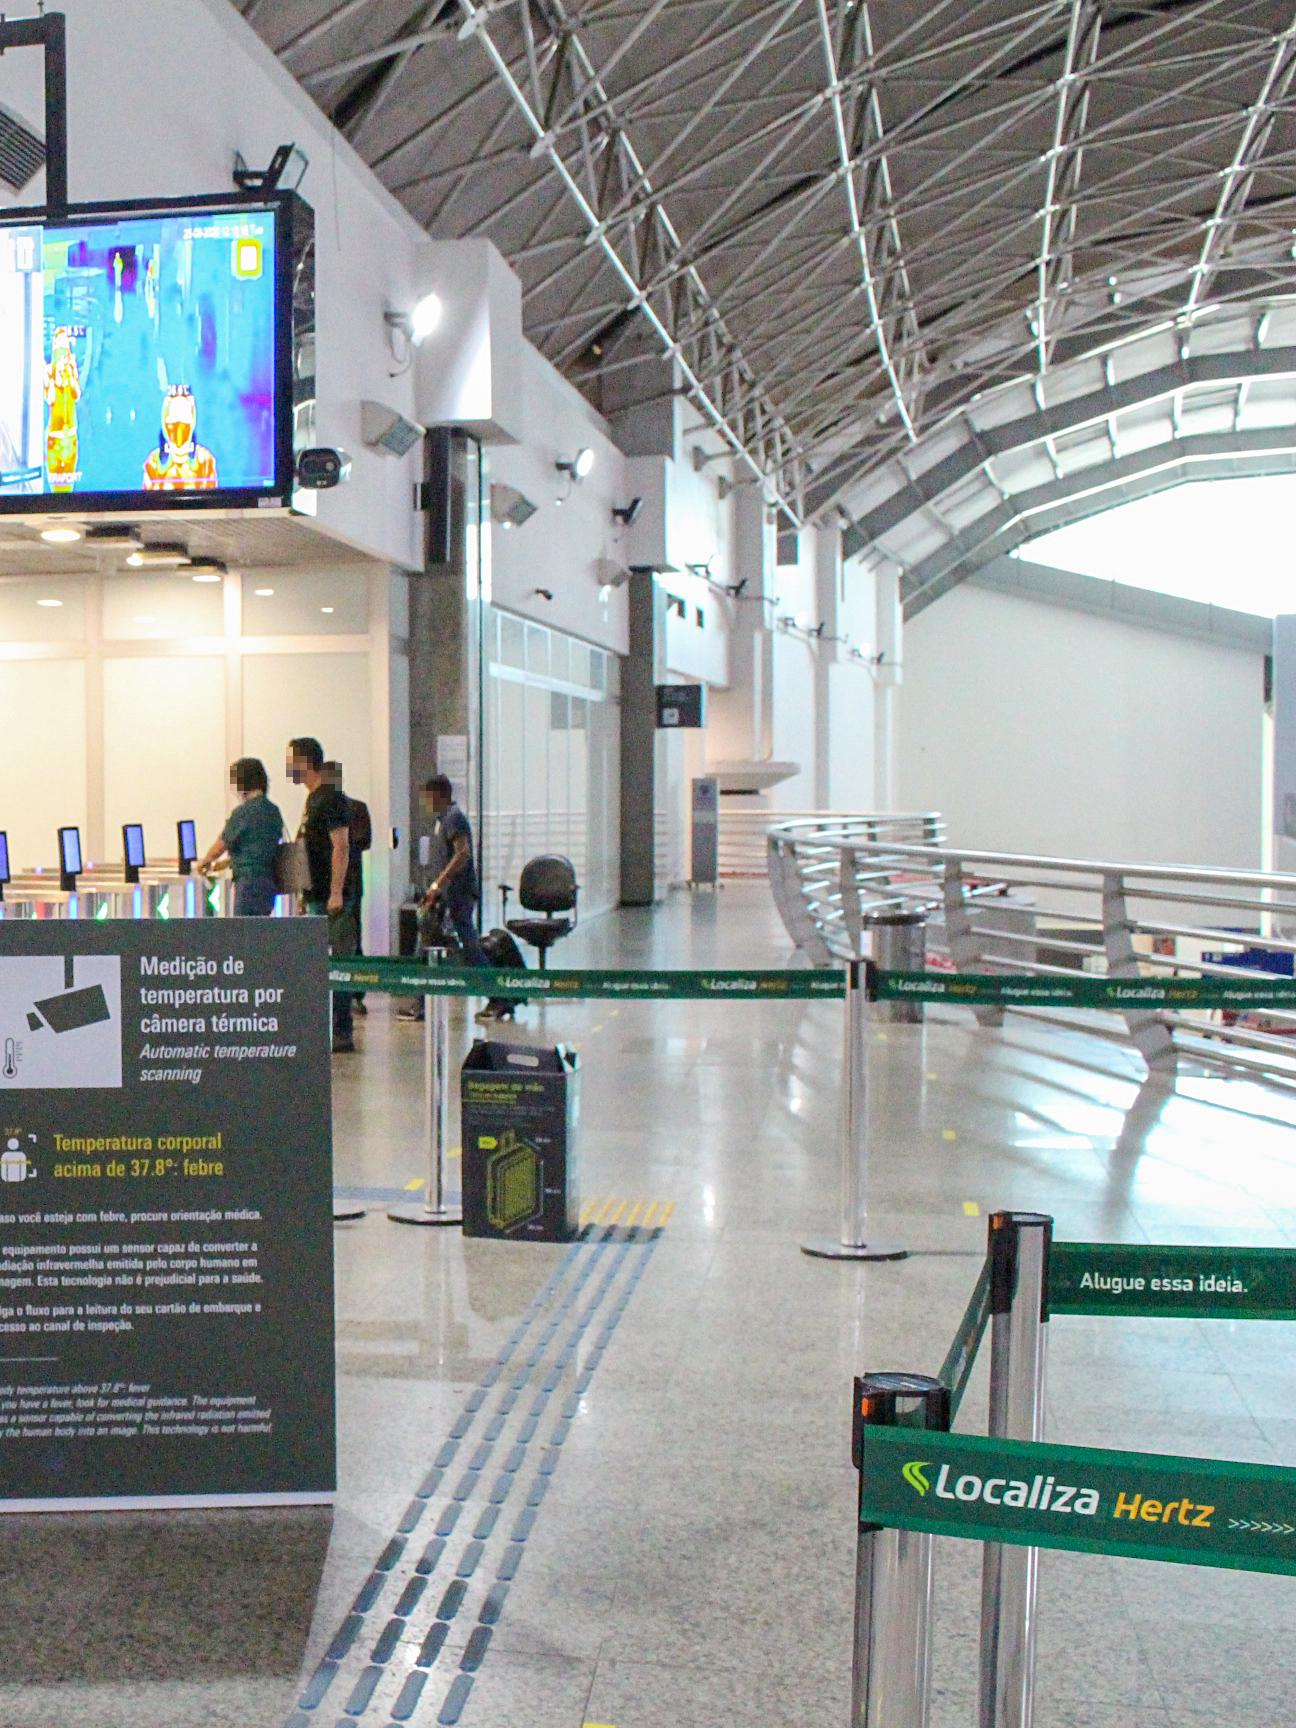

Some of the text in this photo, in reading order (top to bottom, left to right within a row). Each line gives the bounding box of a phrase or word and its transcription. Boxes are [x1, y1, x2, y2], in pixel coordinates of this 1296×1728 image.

[140, 955, 244, 980] Medição de
[505, 977, 551, 989] Localiza
[711, 978, 756, 990] Localiza
[898, 979, 946, 992] Localiza
[1116, 986, 1165, 999] Localiza
[140, 986, 284, 1008] temperatura por
[140, 1012, 278, 1033] câmera térmica
[139, 1043, 297, 1061] Automatic temperature
[140, 1066, 202, 1084] scanning
[53, 1132, 222, 1155] Temperatura corporal
[54, 1161, 101, 1178] acima
[106, 1160, 125, 1177] de
[183, 1158, 224, 1176] febre
[18, 1212, 41, 1223] você
[44, 1211, 73, 1224] esteja
[76, 1213, 97, 1222] com
[100, 1211, 127, 1222] febre,
[131, 1212, 168, 1224] procure
[171, 1209, 222, 1223] orientação
[225, 1208, 262, 1220] médica.
[2, 1244, 66, 1257] equipamento
[69, 1244, 101, 1255] possui
[104, 1245, 120, 1253] um
[122, 1244, 154, 1253] sensor
[157, 1244, 185, 1255] capaz
[188, 1241, 200, 1252] de
[203, 1242, 249, 1252] converter
[251, 1242, 258, 1251] a
[37, 1259, 104, 1270] infravermelha
[107, 1258, 143, 1269] emitida
[146, 1257, 167, 1271] pelo
[170, 1259, 198, 1270] corpo
[200, 1257, 240, 1268] humano
[242, 1258, 258, 1267] em
[37, 1275, 58, 1286] Esta
[61, 1275, 112, 1288] tecnologia
[115, 1274, 133, 1285] não
[136, 1273, 142, 1285] é
[145, 1273, 196, 1287] prejudicial
[199, 1274, 220, 1286] para
[223, 1275, 229, 1283] a
[232, 1272, 263, 1283] saúde.
[1079, 1272, 1249, 1294] Alugue essa ideia.
[17, 1307, 23, 1315] o
[26, 1304, 49, 1315] fluxo
[53, 1306, 74, 1317] para
[77, 1307, 83, 1315] a
[86, 1304, 117, 1315] leitura
[120, 1303, 132, 1314] do
[136, 1305, 153, 1313] seu
[155, 1303, 186, 1313] cartão
[189, 1302, 201, 1313] de
[204, 1302, 252, 1315] embarque
[255, 1303, 261, 1312] e
[29, 1322, 41, 1331] ao
[44, 1320, 69, 1331] canal
[73, 1320, 85, 1331] de
[88, 1319, 134, 1333] inspeção.
[935, 1463, 1216, 1528] Localiza Hertz
